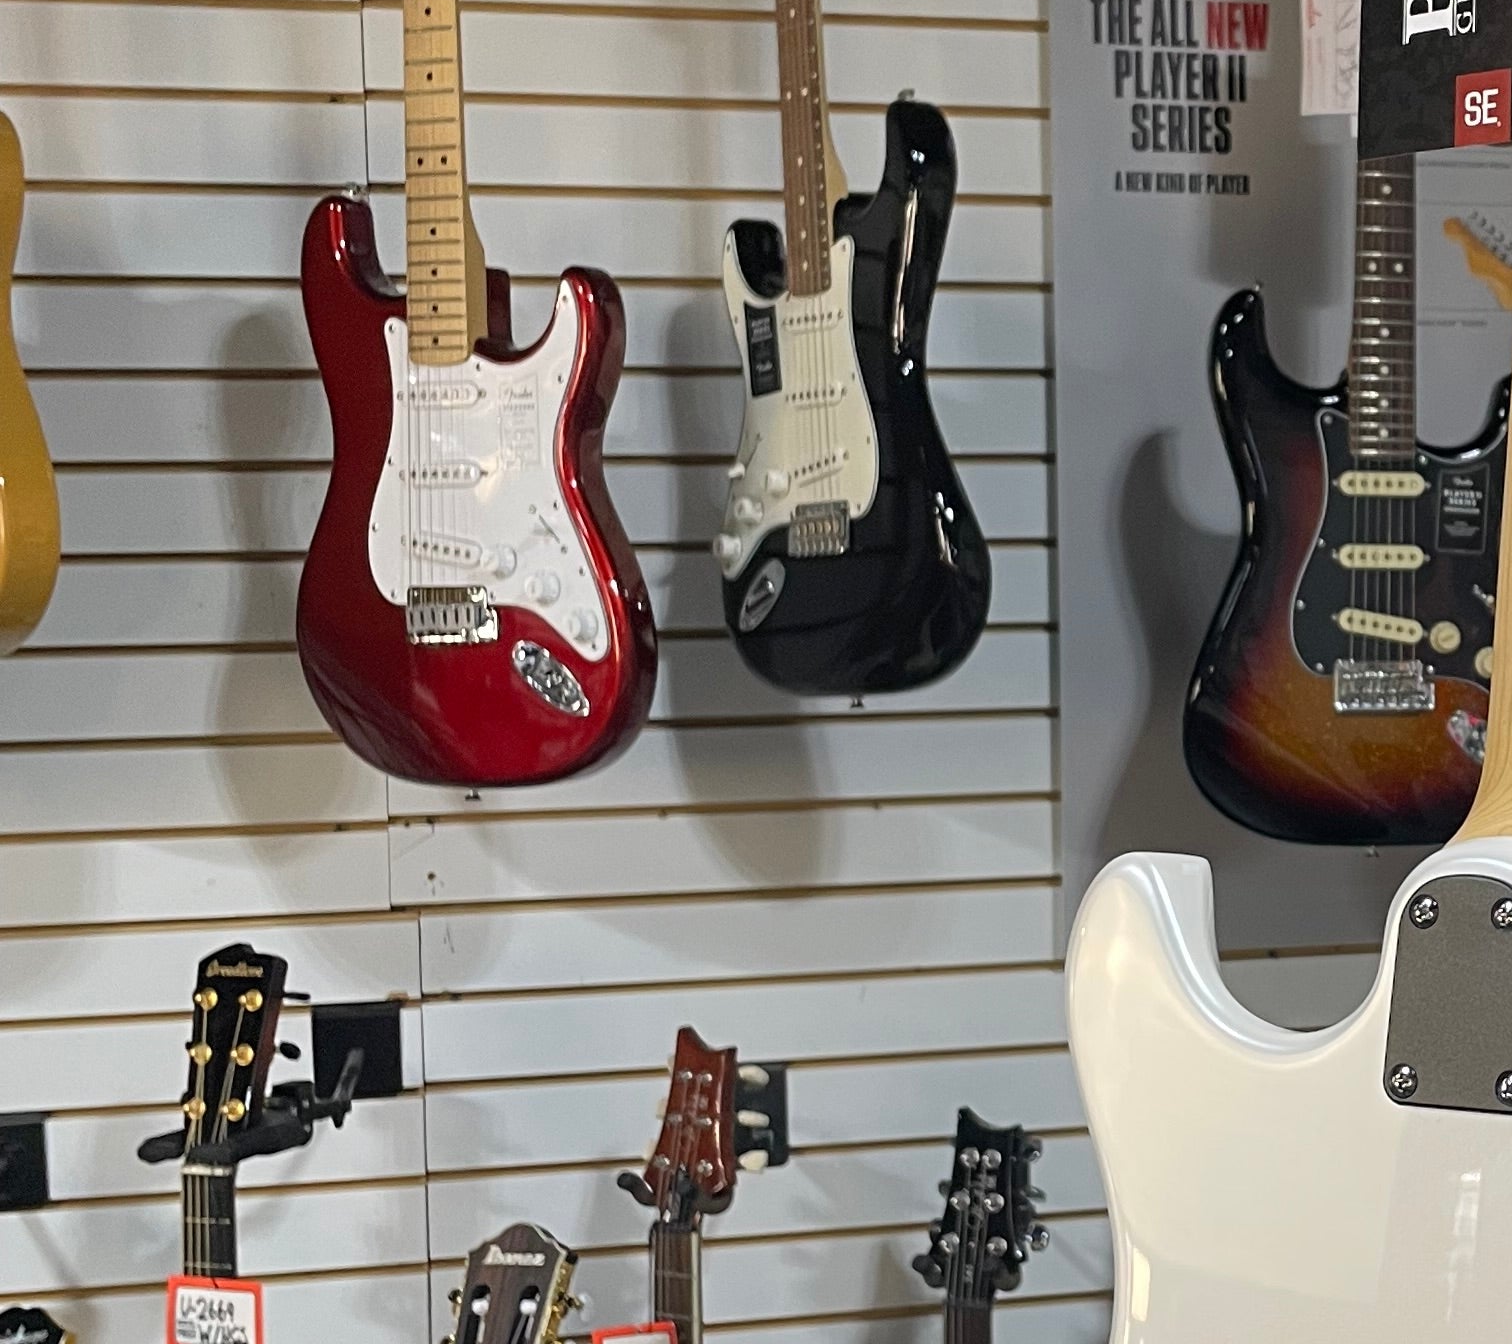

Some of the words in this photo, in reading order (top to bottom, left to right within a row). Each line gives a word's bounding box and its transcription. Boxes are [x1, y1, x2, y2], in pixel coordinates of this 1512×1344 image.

[1206, 1, 1270, 52] NEW
[1114, 49, 1220, 102] PLAYER
[1228, 54, 1248, 103] II
[1131, 103, 1233, 155] SERIES
[1115, 171, 1124, 192] A
[1126, 171, 1152, 193] NEW
[1156, 172, 1186, 194] KIND
[1189, 172, 1204, 194] OF
[1206, 173, 1250, 196] PLAYER
